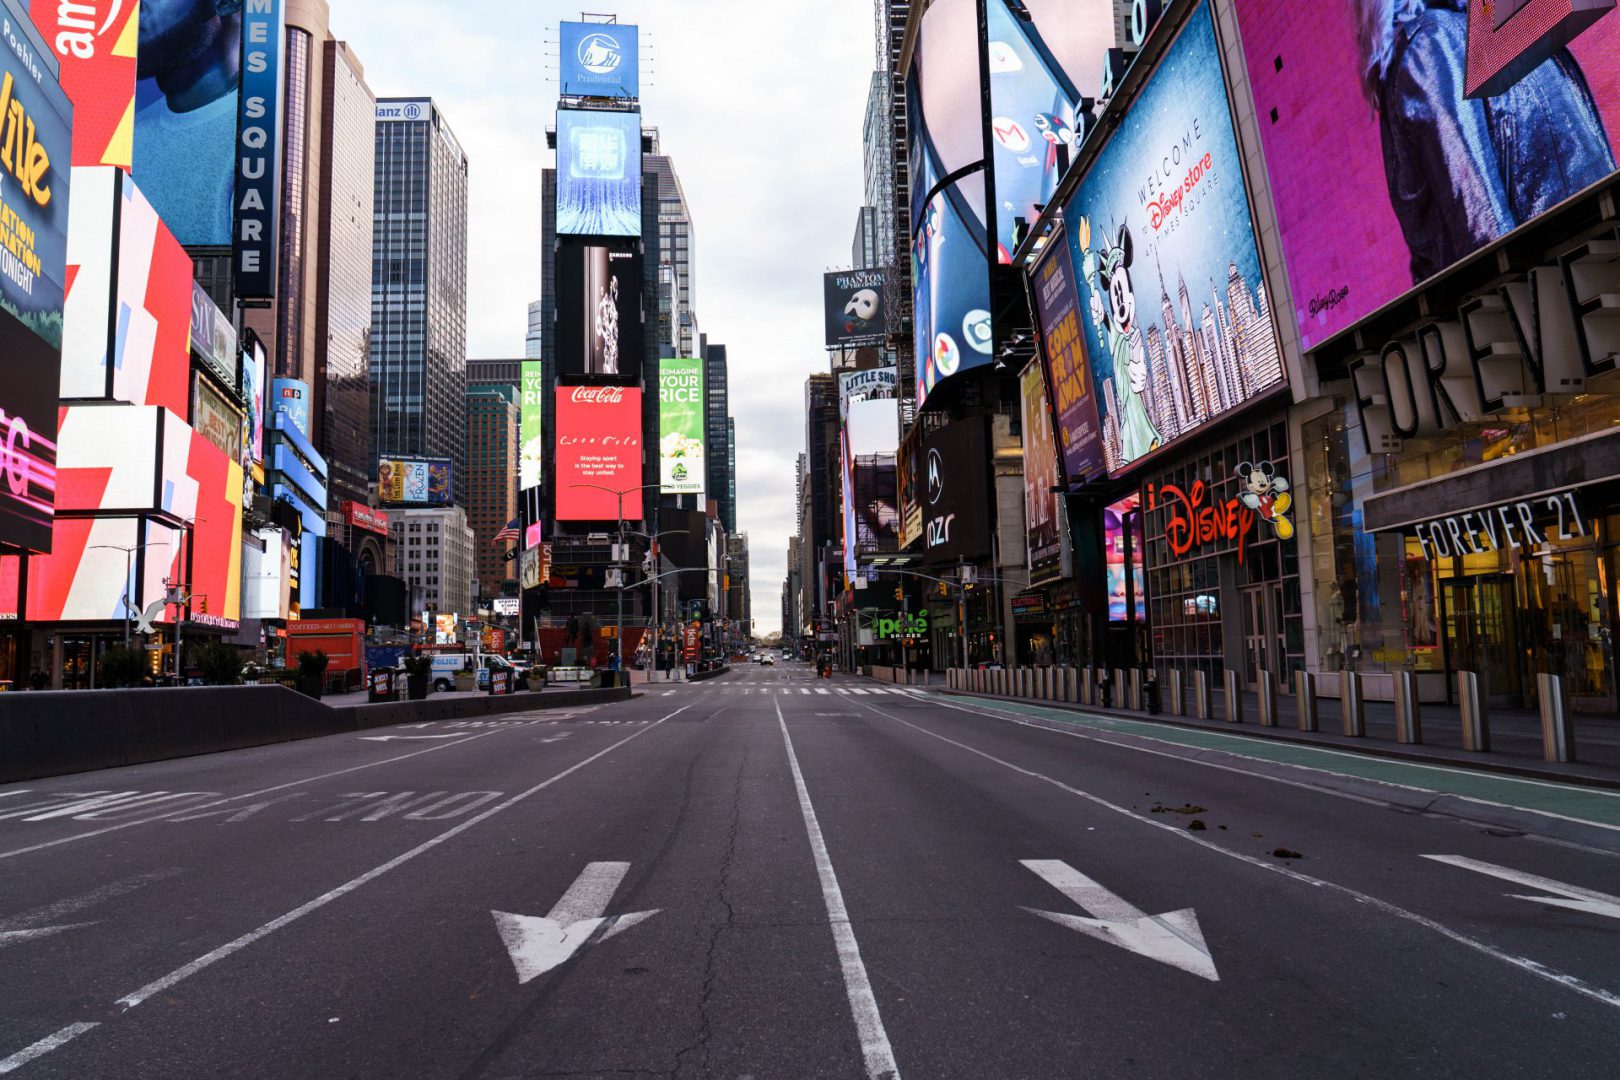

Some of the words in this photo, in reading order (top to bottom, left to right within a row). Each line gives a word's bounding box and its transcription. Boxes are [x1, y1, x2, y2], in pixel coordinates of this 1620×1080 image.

[3, 19, 43, 84] Poehler
[577, 74, 622, 84] Prudential
[1138, 118, 1201, 205] WELCOME
[239, 96, 268, 273] SQUARE
[1146, 186, 1184, 231] Disney
[1183, 152, 1212, 193] store
[836, 273, 886, 286] PHANTOM
[1047, 309, 1079, 359] COME
[1348, 226, 1620, 455] FOREVE
[659, 376, 699, 388] YOUR
[846, 370, 876, 392] LITTLE
[1051, 338, 1085, 387] FROM
[571, 386, 624, 403] Coca-Cola
[658, 388, 700, 403] RICE
[1057, 364, 1086, 415] AWAY
[413, 464, 424, 500] FROZEN
[1415, 502, 1542, 561] FOREVER
[1547, 492, 1585, 540] 21
[687, 628, 696, 646] tkts
[431, 658, 459, 666] POLICE
